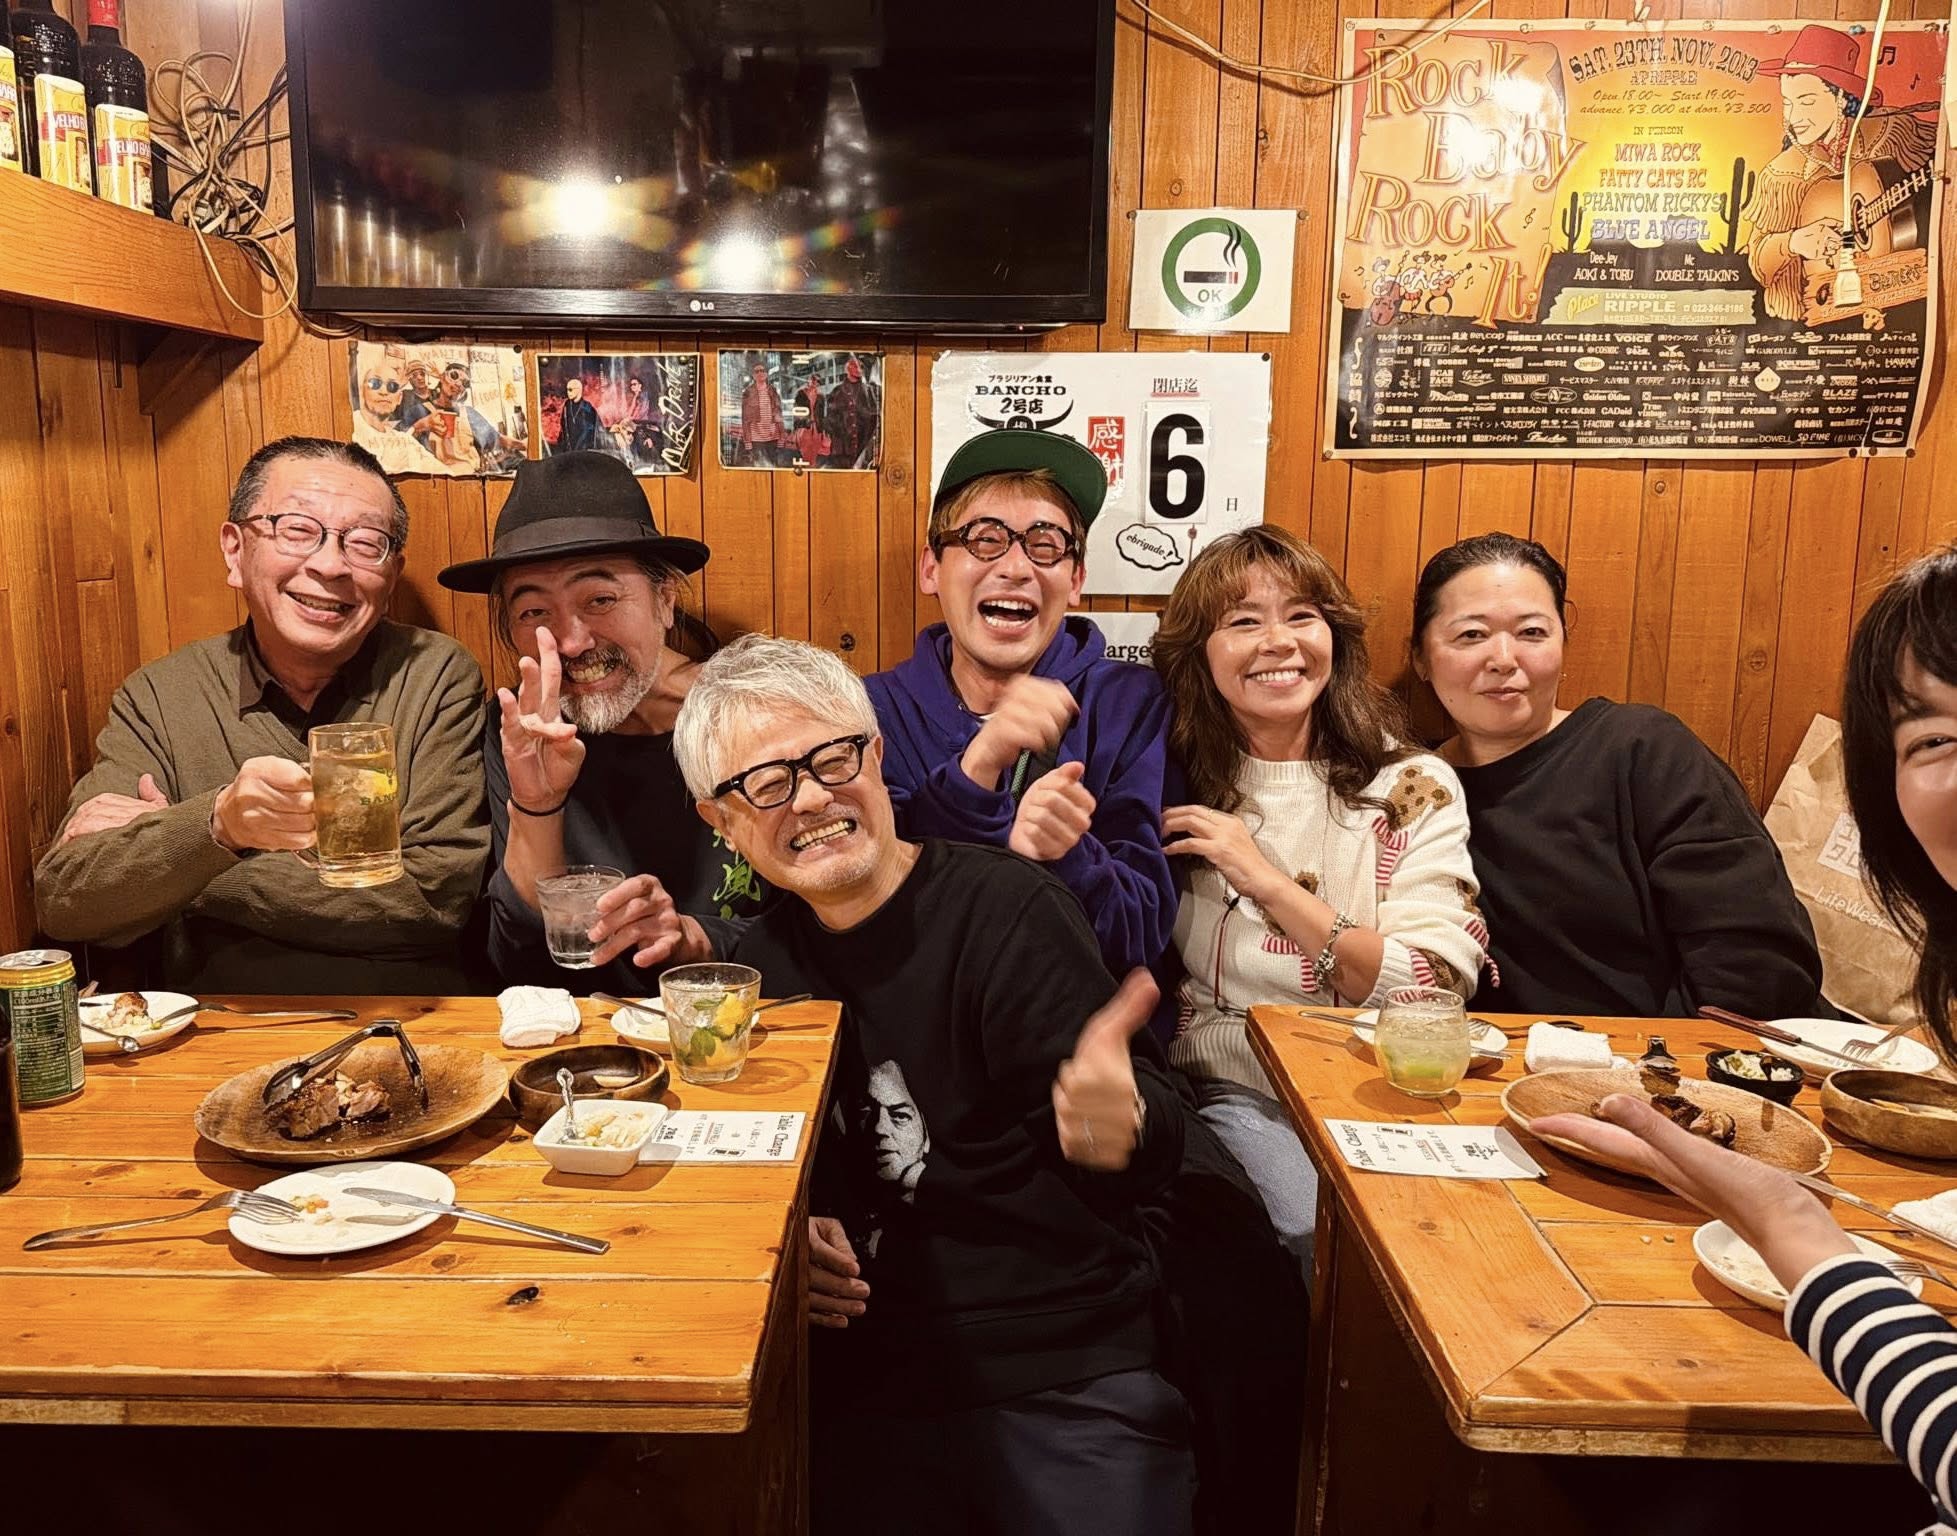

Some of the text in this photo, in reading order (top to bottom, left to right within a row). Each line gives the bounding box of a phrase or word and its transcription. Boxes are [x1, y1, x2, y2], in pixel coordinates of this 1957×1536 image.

[1672, 37, 1717, 69] NOV.
[1716, 45, 1759, 84] 2013
[1614, 143, 1702, 162] MIWA ROCK
[1599, 168, 1644, 188] FATTY
[1646, 168, 1685, 188] CATS
[1582, 192, 1658, 213] PHANTOM
[1592, 218, 1711, 241] BLUE ANGEL
[1573, 268, 1635, 281] AOKI & TORU
[1654, 269, 1695, 282] DOUBLE
[1197, 289, 1223, 303] OK
[1604, 301, 1677, 313] RIPPLE
[1544, 333, 1564, 341] ACC
[1613, 332, 1655, 343] VOICE
[975, 385, 1067, 396] BANCHO
[1152, 377, 1199, 394] 閉店迄
[1822, 388, 1859, 397] BLAZE
[1000, 398, 1044, 415] 2号店
[1827, 406, 1857, 414] セカンド
[1150, 413, 1206, 520] 6
[1226, 497, 1238, 512] 日
[1101, 643, 1150, 662] arge
[1814, 886, 1890, 930] LifeWear
